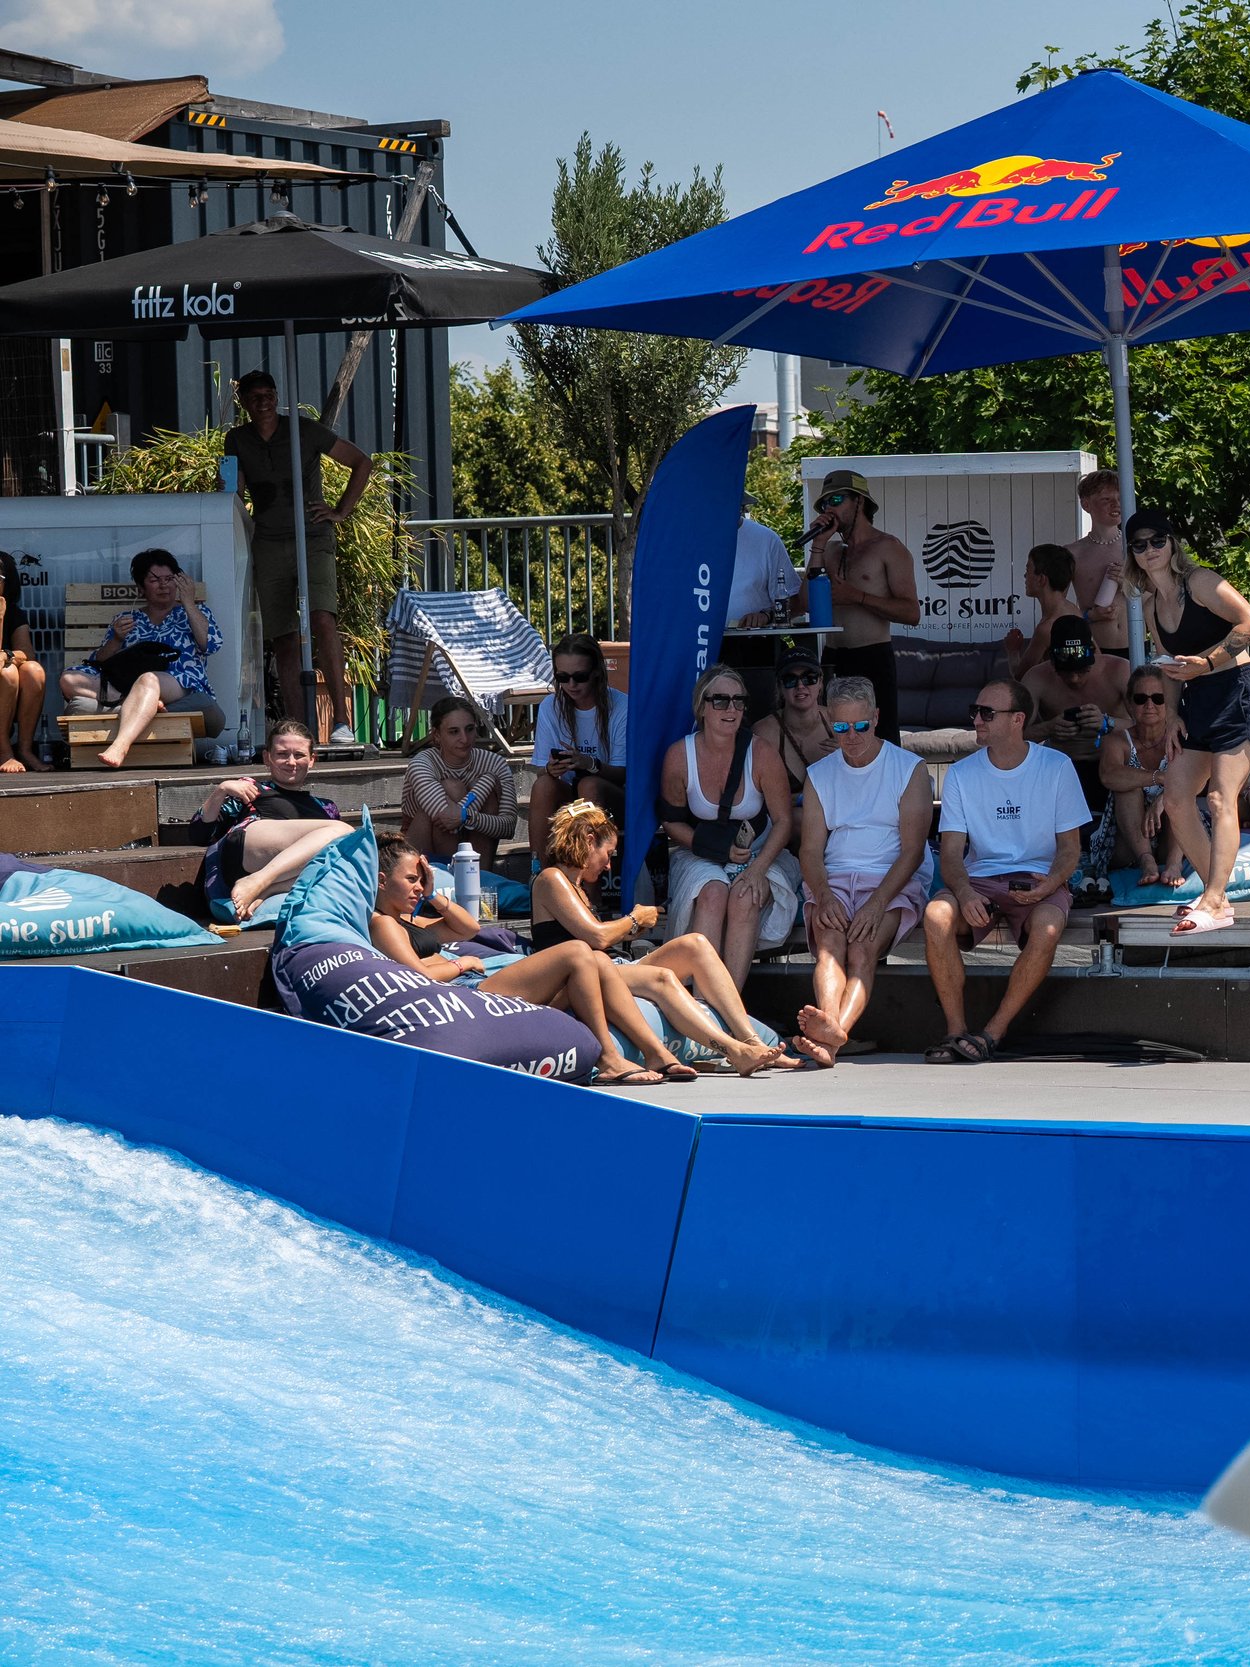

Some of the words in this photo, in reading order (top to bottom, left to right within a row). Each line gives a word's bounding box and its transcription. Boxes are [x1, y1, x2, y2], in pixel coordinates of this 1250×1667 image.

[801, 201, 964, 254] Red
[955, 187, 1121, 229] Bull
[20, 571, 48, 587] Bull
[693, 562, 711, 612] do
[957, 594, 1022, 619] surf.
[941, 622, 972, 630] COFFEE
[974, 622, 990, 630] AND
[992, 622, 1019, 630] WAVES
[996, 806, 1021, 815] SURF
[50, 909, 118, 945] surf.
[300, 950, 364, 991] BIONADE!
[375, 991, 476, 1040] WELLE
